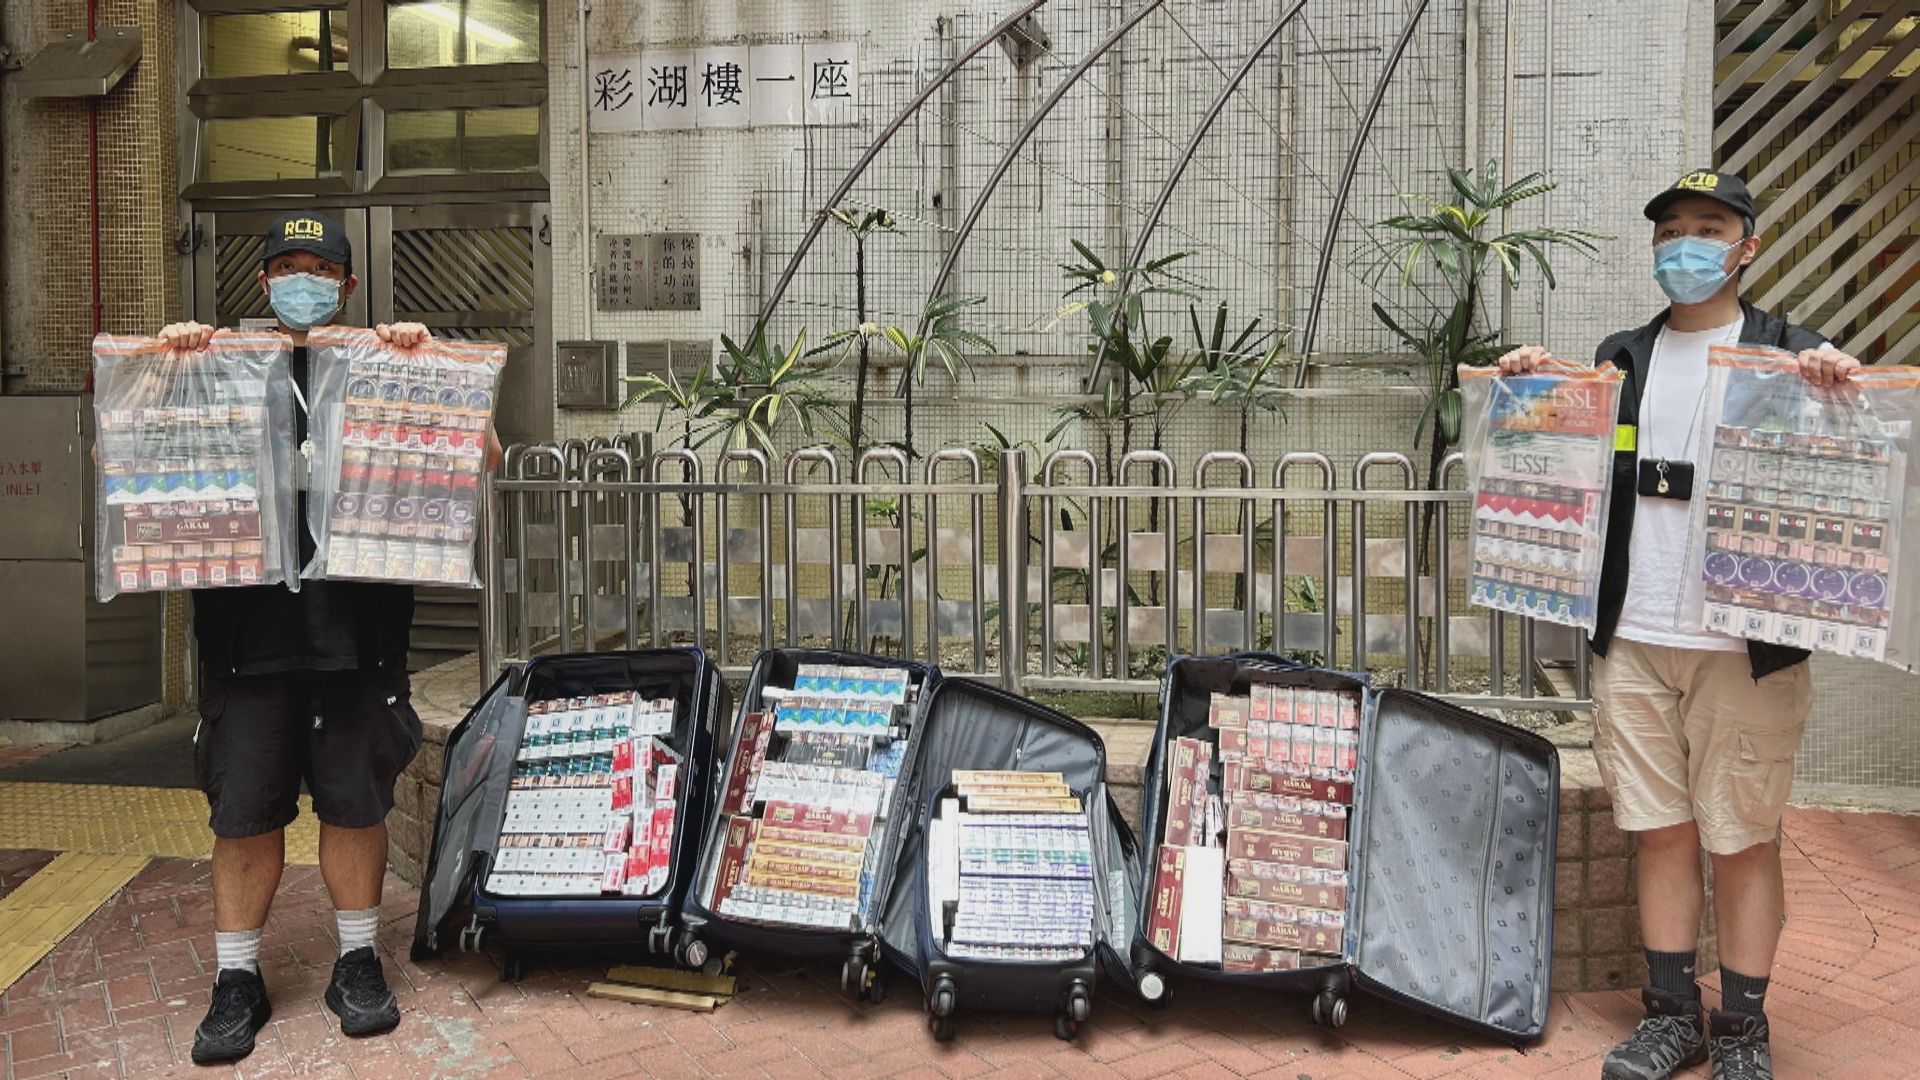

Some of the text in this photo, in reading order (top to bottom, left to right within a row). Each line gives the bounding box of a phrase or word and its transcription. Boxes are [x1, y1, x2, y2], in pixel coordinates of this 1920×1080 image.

[593, 57, 852, 111] 彩湖樓一座
[285, 218, 324, 237] RCIB
[681, 237, 695, 306] 保持清潔
[1552, 388, 1598, 409] ESSE
[1510, 454, 1553, 476] ESSE
[6, 482, 41, 496] INLET
[176, 521, 210, 530] GARAM
